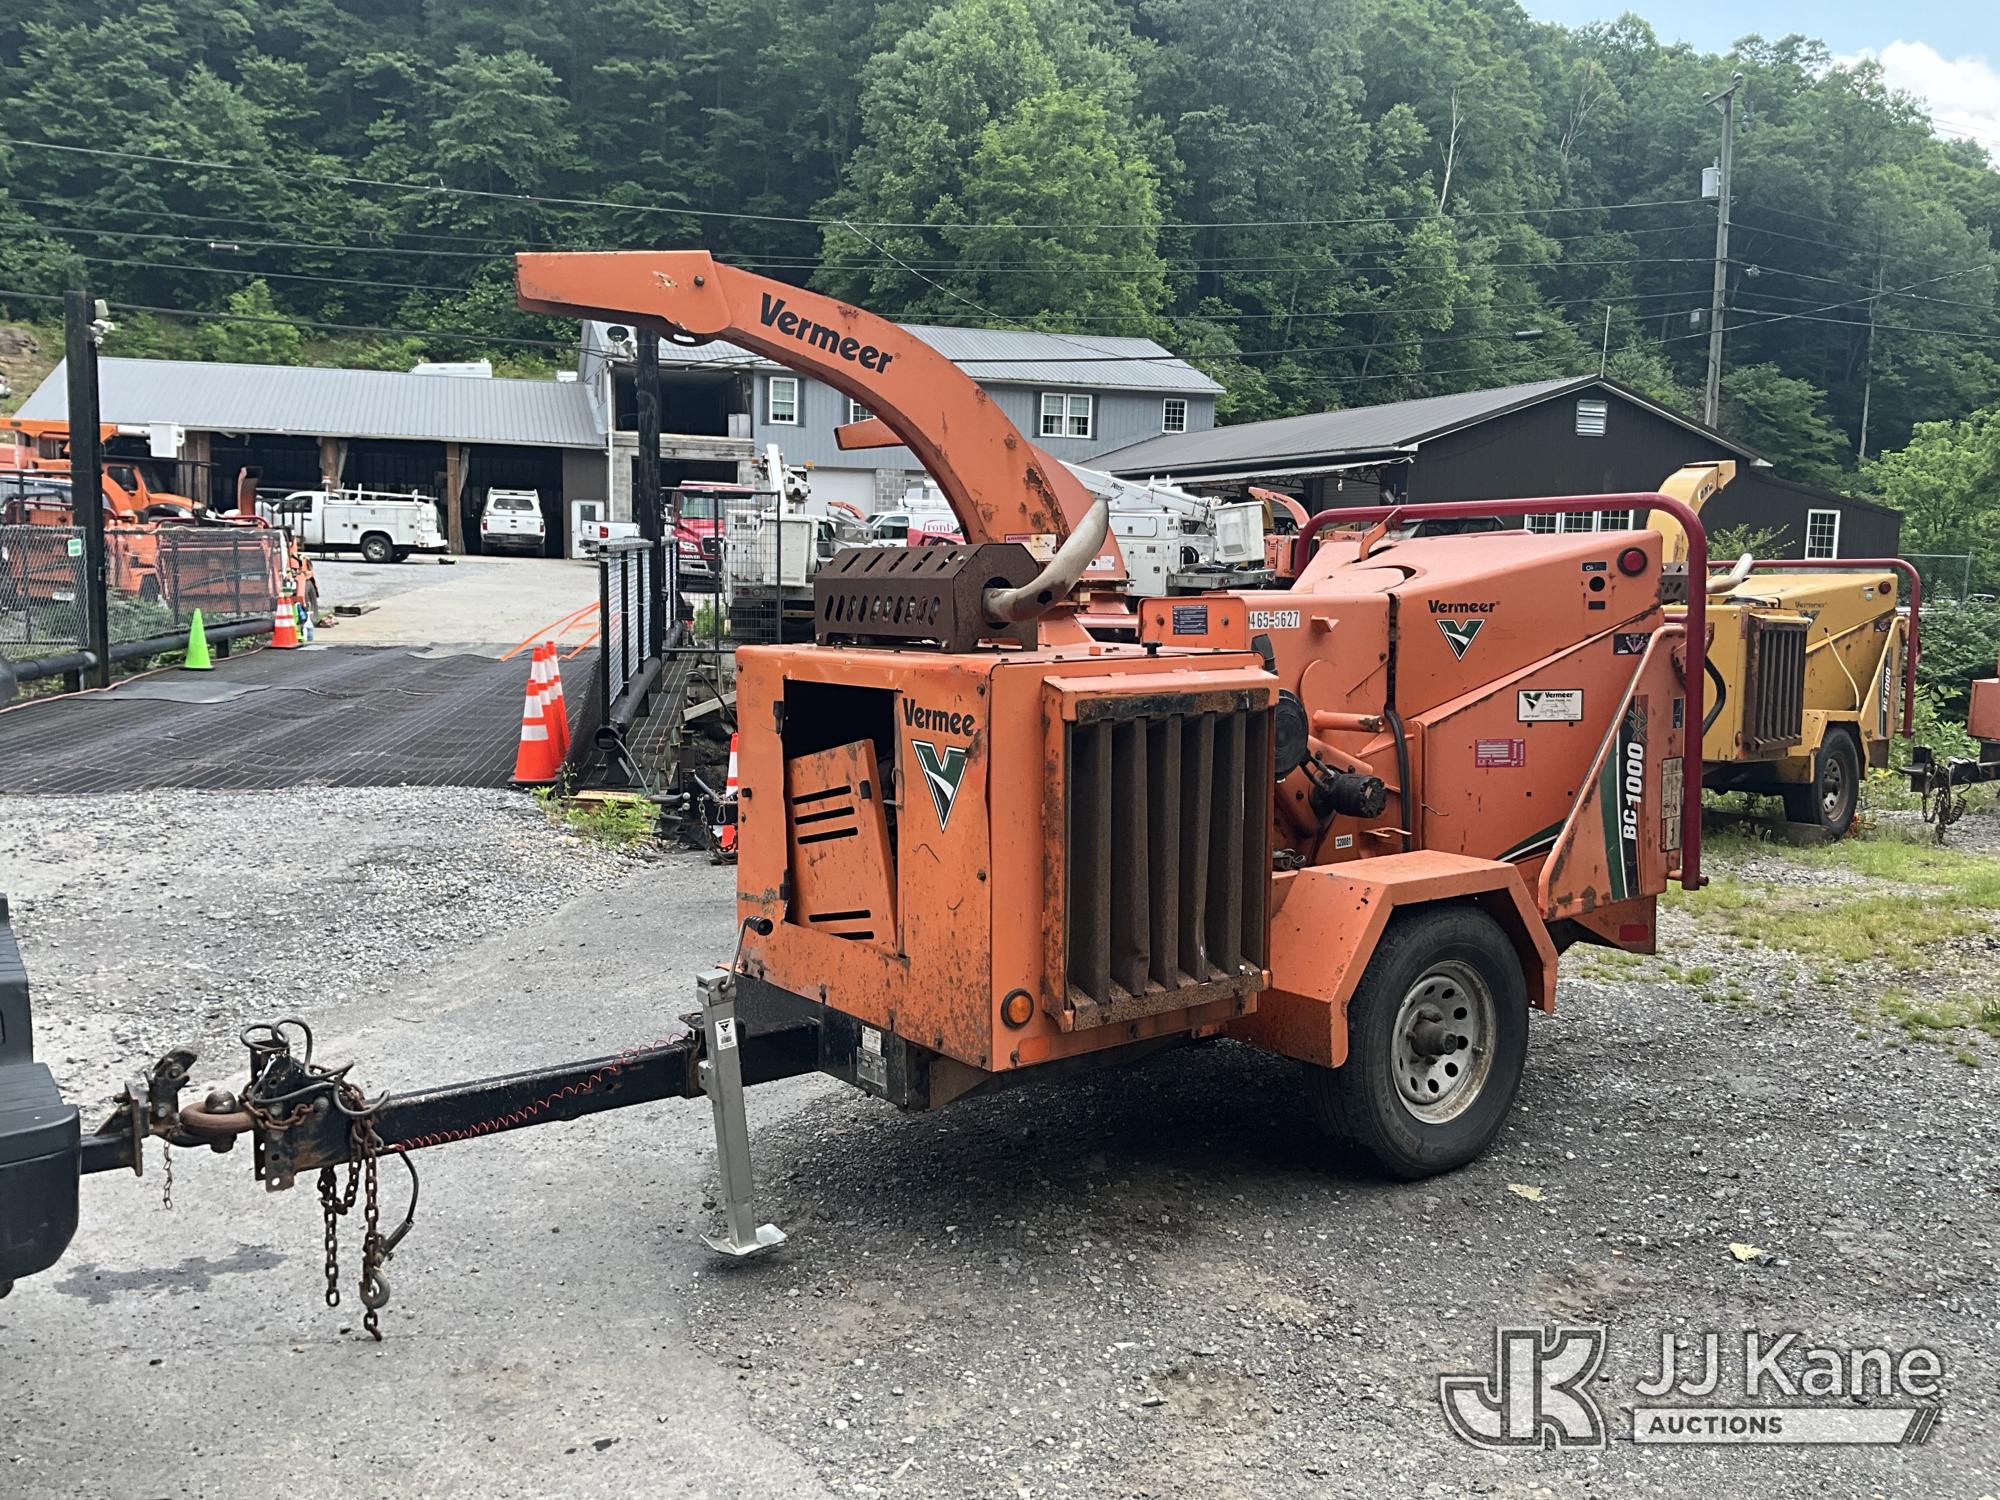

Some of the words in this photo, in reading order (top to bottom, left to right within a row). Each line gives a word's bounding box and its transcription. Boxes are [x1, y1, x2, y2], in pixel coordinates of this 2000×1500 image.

[760, 292, 893, 374] Vermeer
[1249, 611, 1299, 629] 465-5627
[1428, 600, 1495, 613] Vermeer
[1625, 742, 1644, 803] 1000
[1622, 809, 1637, 841] BC
